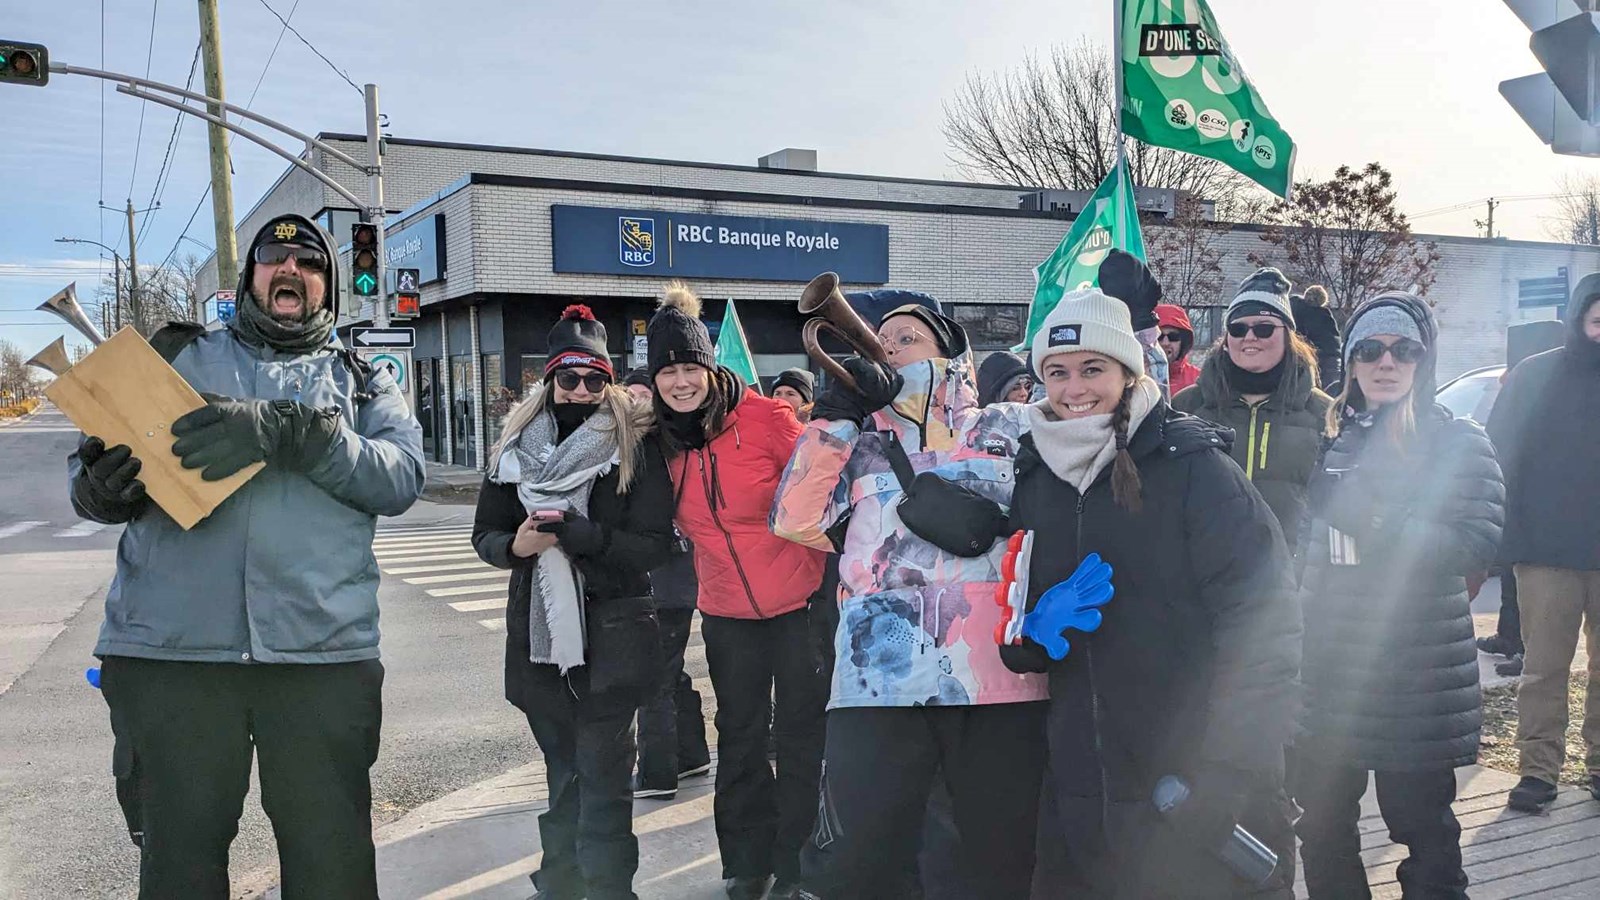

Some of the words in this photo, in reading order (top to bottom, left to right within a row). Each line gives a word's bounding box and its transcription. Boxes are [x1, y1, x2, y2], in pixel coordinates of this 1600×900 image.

[1146, 29, 1191, 51] D'UNE
[1170, 116, 1188, 126] CSN
[1211, 117, 1227, 127] CSQ
[1254, 145, 1272, 160] APTS
[677, 224, 714, 243] RBC
[718, 227, 781, 250] Banque
[785, 230, 839, 253] Royale
[624, 251, 651, 262] RBC
